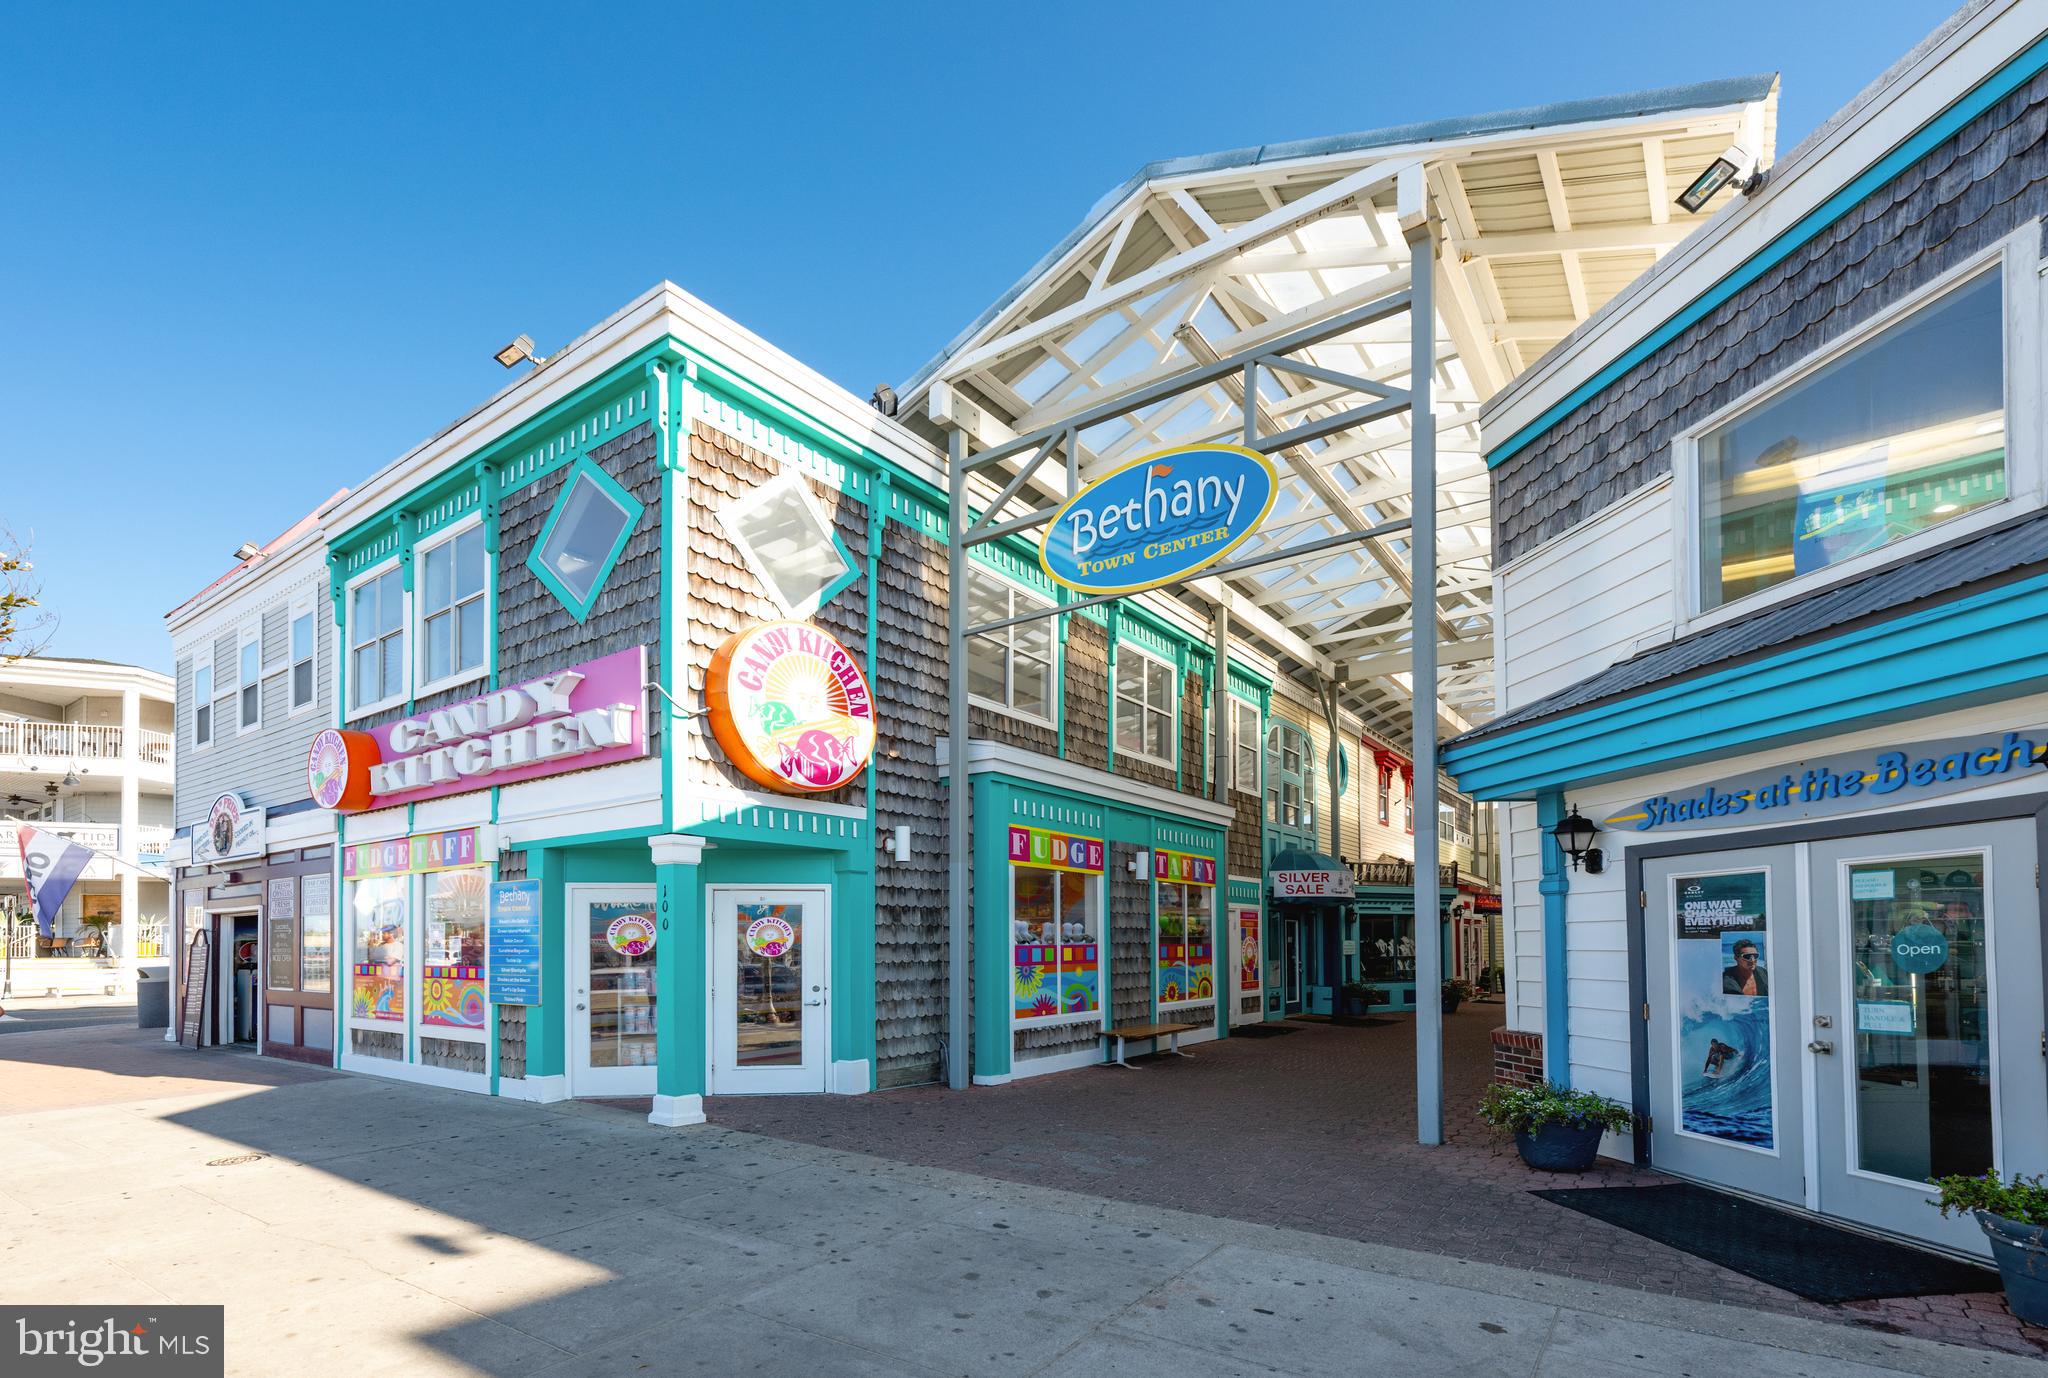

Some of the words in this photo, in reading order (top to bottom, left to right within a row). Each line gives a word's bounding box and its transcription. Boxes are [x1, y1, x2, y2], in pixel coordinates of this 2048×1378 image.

[1067, 464, 1246, 556] Bethany
[1077, 551, 1137, 577] TOWN
[1143, 526, 1231, 560] CENTER
[738, 627, 793, 691] CANDY
[796, 627, 869, 719] KITCHEN
[389, 669, 586, 753] CANDY
[368, 702, 637, 796] KITCHEN
[1636, 788, 1750, 831] Shades
[1754, 774, 1792, 810] at
[1798, 767, 1866, 803] the
[1868, 731, 2035, 796] Beach
[81, 832, 116, 841] TIDE
[345, 843, 408, 872] FUDGE
[414, 834, 481, 864] TAFF
[1011, 832, 1102, 866] FUDGE
[1156, 855, 1215, 881] TAFFY
[1278, 872, 1330, 883] SILVER
[499, 886, 530, 906] Bethany
[1285, 884, 1325, 894] SALE
[661, 884, 669, 930] 100
[1684, 901, 1707, 910] ONE
[1708, 899, 1742, 909] WAVE
[1684, 908, 1737, 918] CHANGES
[609, 917, 627, 936] CANDY
[628, 916, 655, 935] KITCHEN
[749, 919, 765, 937] CANDY
[766, 918, 792, 937] KITCHEN
[1685, 916, 1754, 926] EVERYTHING
[1896, 943, 1941, 957] Open
